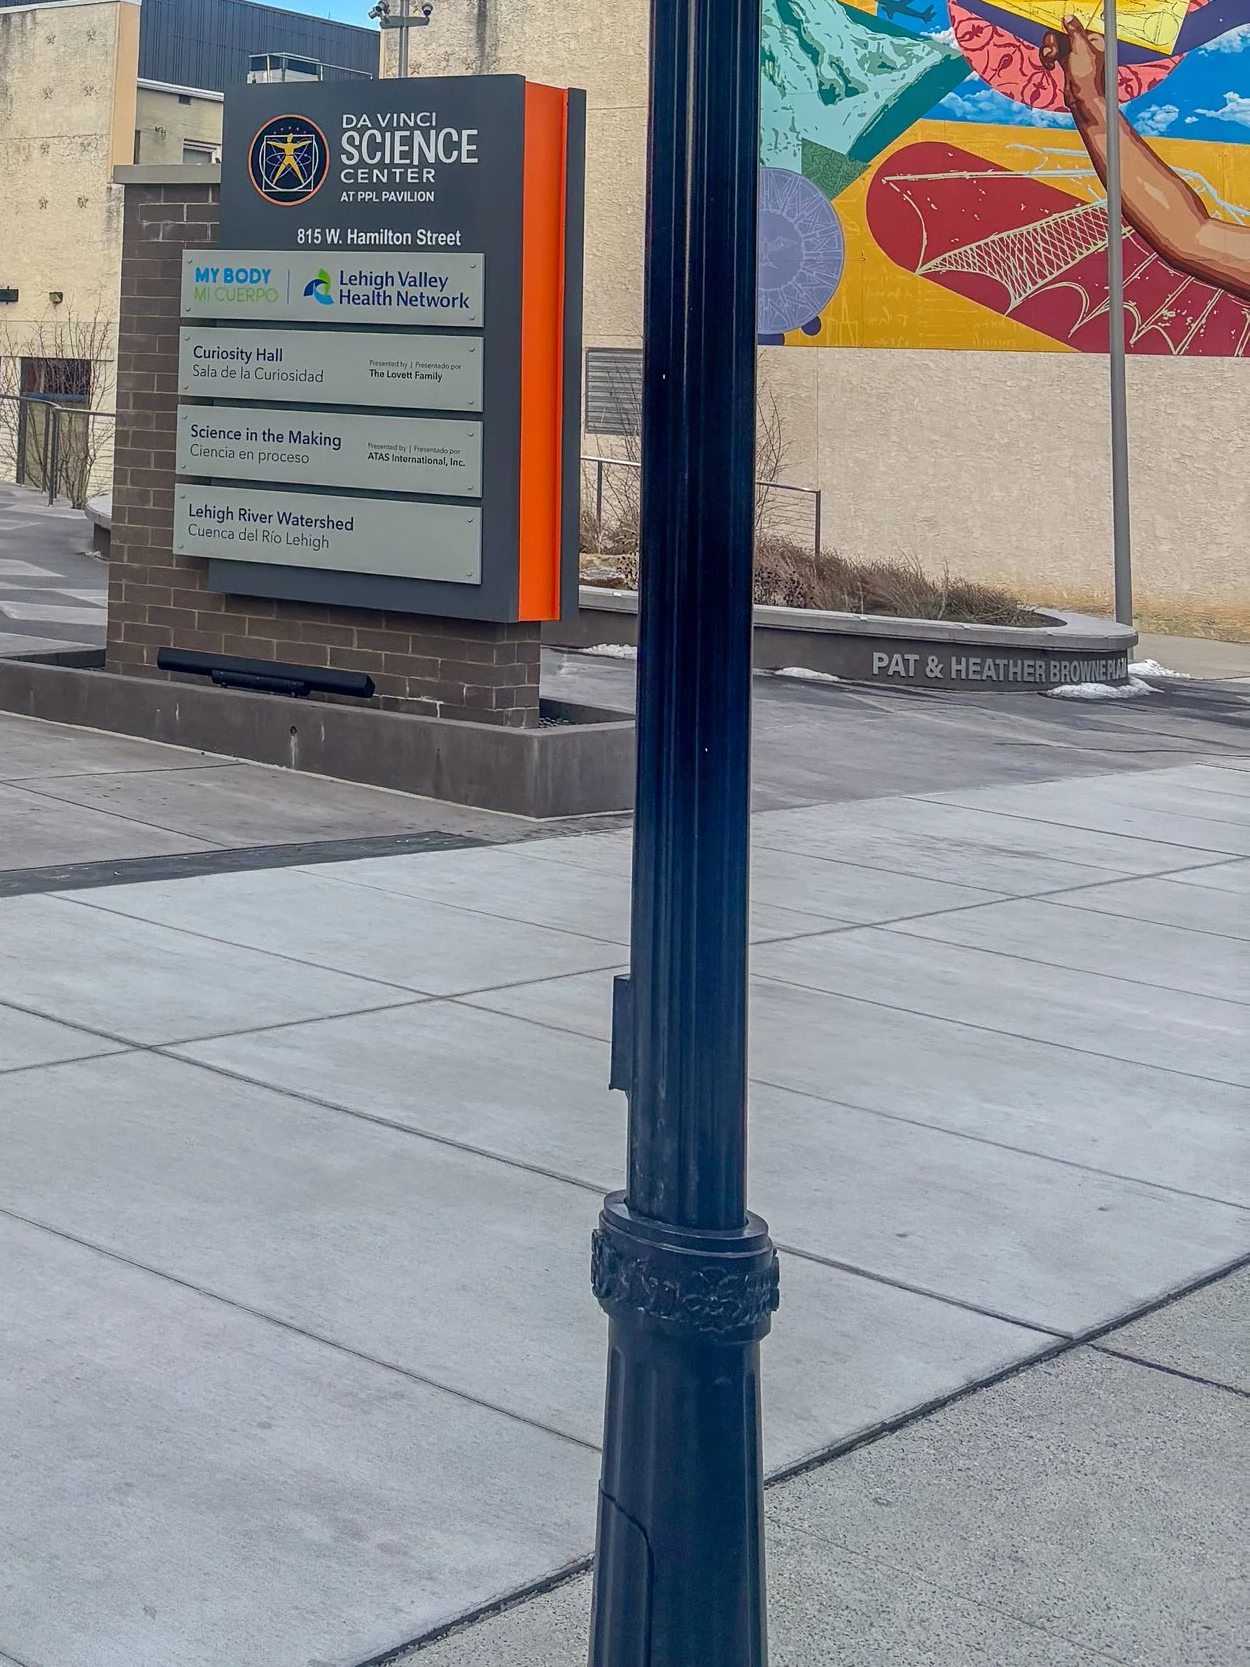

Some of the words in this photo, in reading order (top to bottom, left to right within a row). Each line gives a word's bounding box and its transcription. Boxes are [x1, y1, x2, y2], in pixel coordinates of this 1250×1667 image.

[342, 114, 373, 129] DA
[377, 112, 437, 127] VINCI
[340, 127, 479, 167] SCIENCE
[340, 168, 436, 184] CENTER
[340, 191, 354, 203] AT
[357, 190, 378, 202] PPL
[381, 190, 434, 202] PAVILION
[297, 229, 322, 245] 815
[325, 229, 343, 245] W.
[347, 228, 412, 245] Hamilton
[416, 229, 462, 246] Street
[195, 267, 219, 283] MY
[223, 268, 271, 284] BODY
[340, 270, 394, 290] Lehigh
[397, 271, 449, 291] Valley
[194, 288, 210, 300] MI
[214, 287, 279, 303] CUERPO
[339, 288, 392, 307] Health
[396, 291, 470, 309] Network
[193, 345, 252, 364] Curiosity
[256, 348, 283, 362] Hall
[192, 365, 217, 379] Sala
[220, 366, 237, 379] de
[240, 367, 251, 380] la
[254, 367, 324, 383] Curiosidad
[416, 361, 449, 369] Presentado
[370, 369, 384, 378] The
[387, 370, 412, 379] Lovett
[415, 371, 442, 382] Family
[190, 424, 242, 441] Science
[246, 426, 258, 442] in
[262, 428, 284, 443] the
[288, 430, 342, 450] Making
[190, 443, 235, 459] Ciencia
[238, 450, 254, 460] en
[258, 450, 309, 464] proceso
[368, 442, 397, 450] Presented
[399, 444, 406, 452] by
[414, 445, 448, 454] Presentado
[367, 452, 389, 461] ATAS
[392, 454, 448, 466] International,
[450, 458, 465, 466] Inc.
[189, 504, 234, 523] Lehigh
[238, 508, 273, 524] River
[277, 511, 354, 531] Watershed
[188, 524, 235, 540] Cuenca
[238, 527, 258, 542] del
[262, 528, 282, 544] Río
[286, 531, 329, 550] Lehigh
[872, 652, 920, 677] PAT
[926, 655, 944, 679] &
[951, 657, 1046, 683] HEATHER
[1050, 660, 1106, 681] BROWNE
